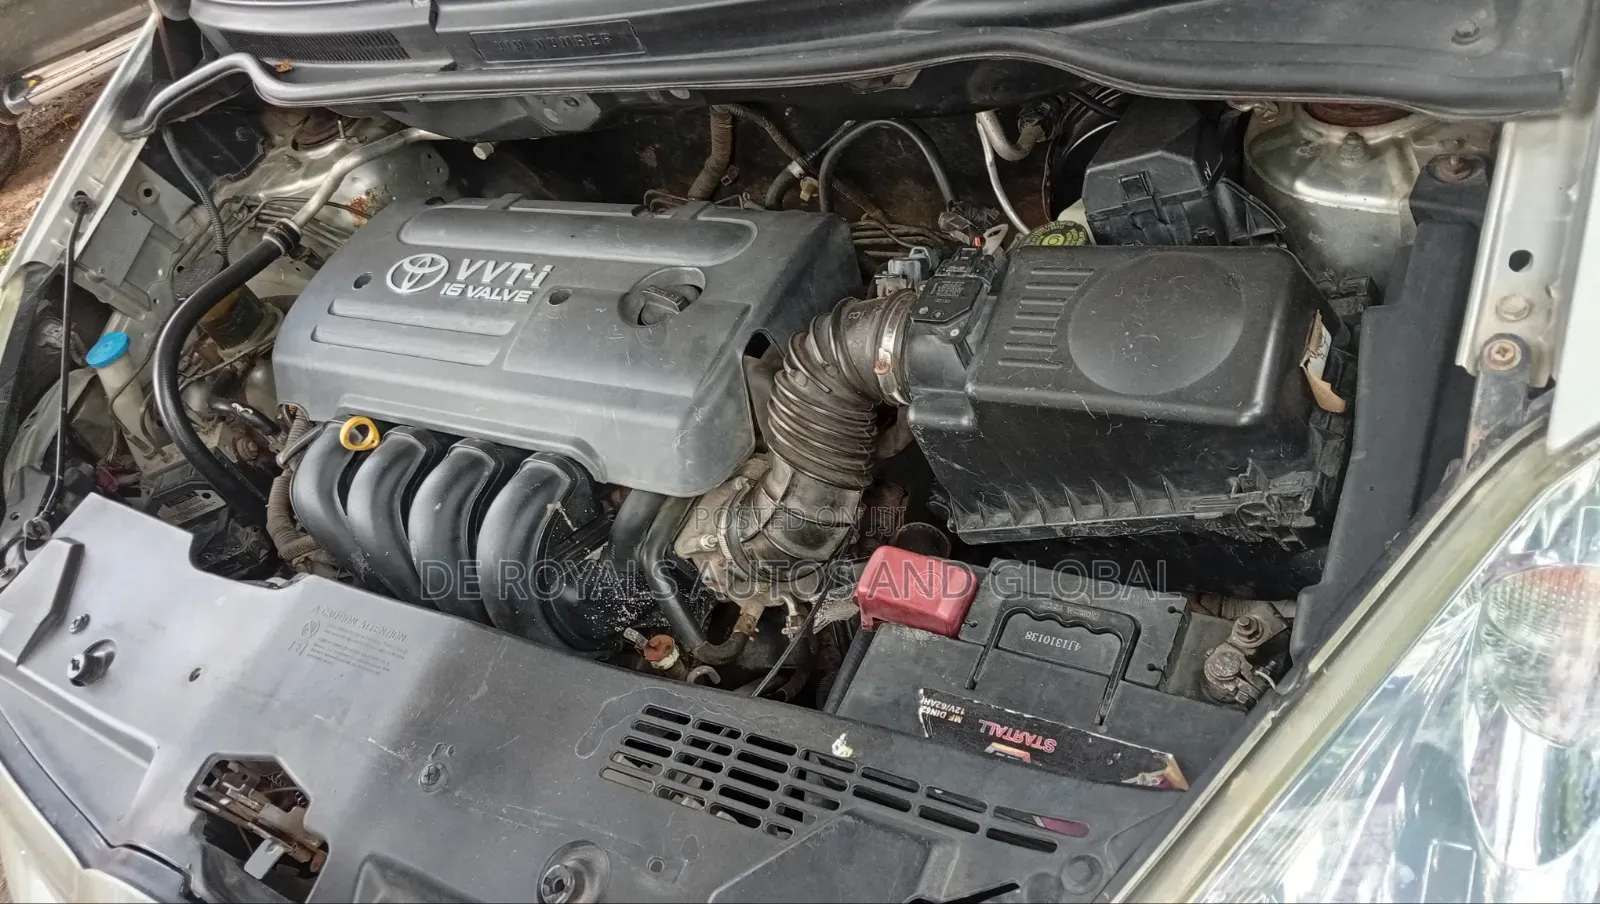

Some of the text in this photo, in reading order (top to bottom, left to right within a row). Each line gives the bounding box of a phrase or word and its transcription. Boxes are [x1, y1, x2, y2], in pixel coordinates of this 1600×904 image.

[533, 32, 613, 50] NUMBER
[456, 258, 555, 288] VVT-i
[440, 283, 534, 304] 16 VALVE
[1025, 630, 1082, 652] 4J1310138
[947, 715, 963, 724] MF
